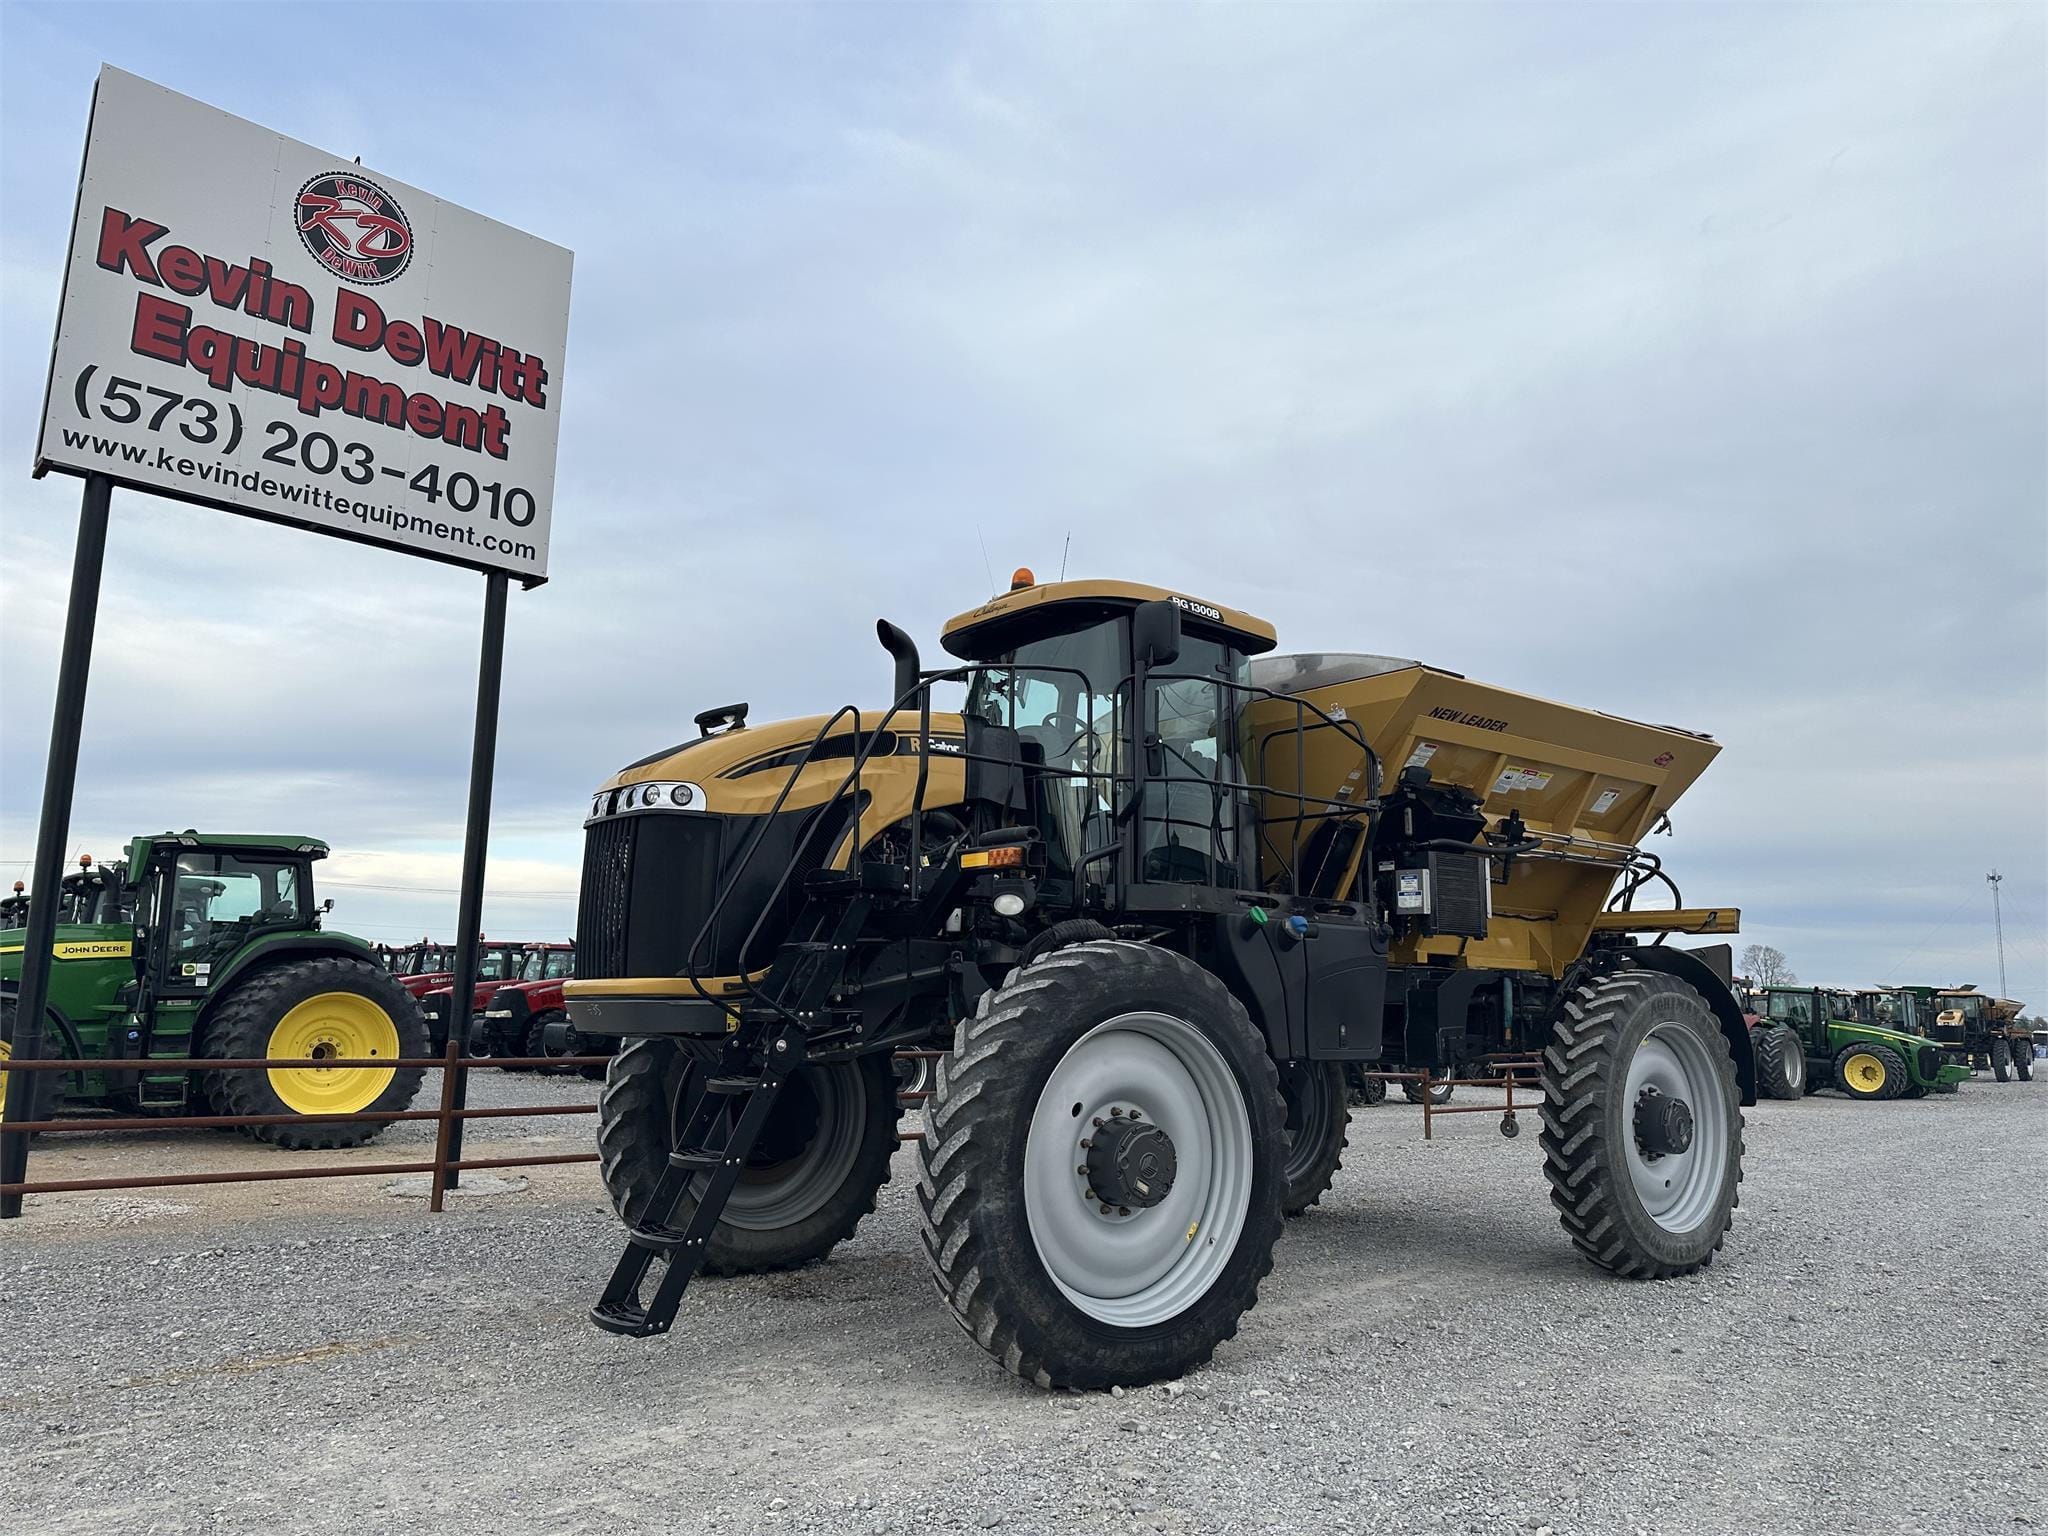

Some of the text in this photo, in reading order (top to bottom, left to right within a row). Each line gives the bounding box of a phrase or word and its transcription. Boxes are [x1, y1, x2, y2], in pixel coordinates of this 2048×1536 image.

[335, 180, 383, 209] Kevin
[320, 246, 380, 278] DeWitt
[96, 205, 549, 410] Kevin DeWitt
[130, 291, 511, 461] Equipment
[74, 364, 537, 528] (573) 203-4010
[62, 428, 536, 560] www.kevindewittequipment.com
[1171, 596, 1220, 620] RG 1300B
[1428, 706, 1508, 732] NEW LEADER
[62, 945, 126, 954] JOHN DEERE
